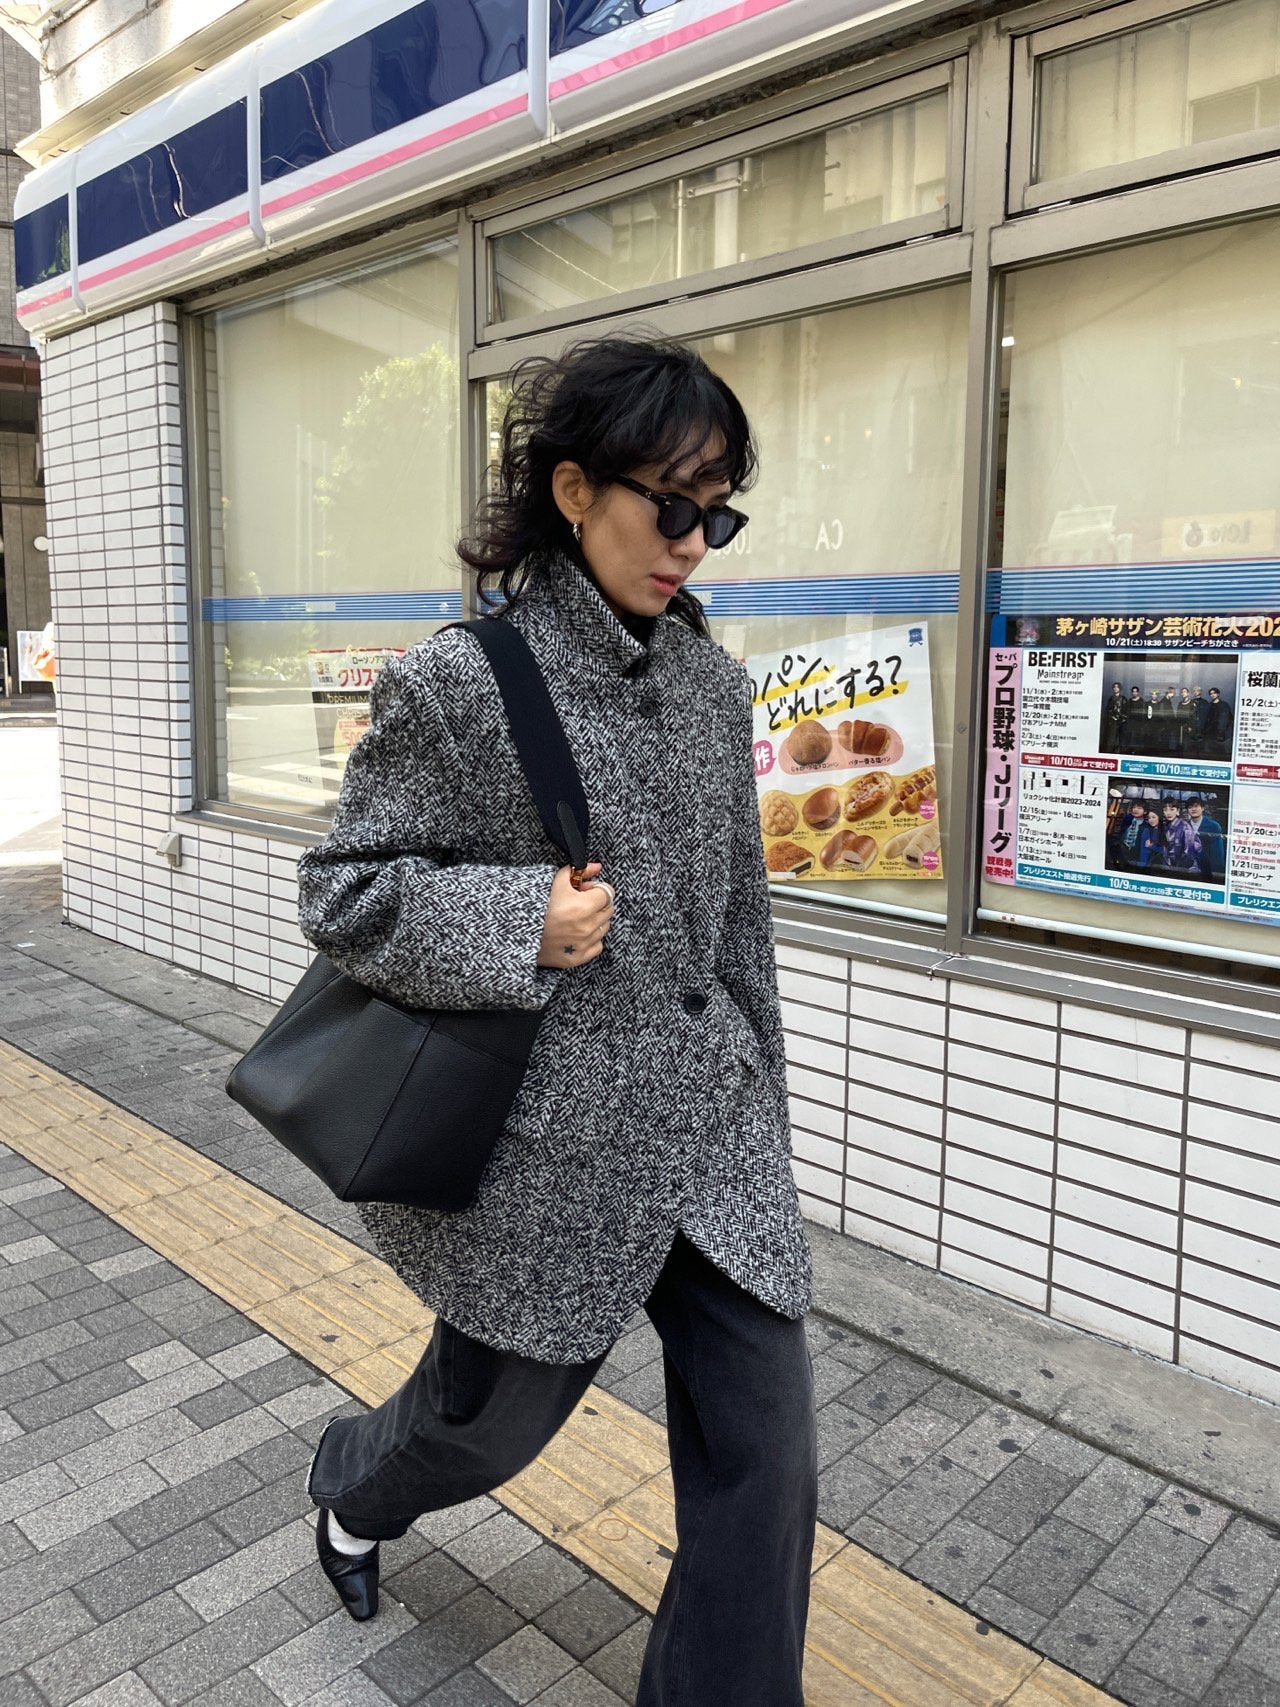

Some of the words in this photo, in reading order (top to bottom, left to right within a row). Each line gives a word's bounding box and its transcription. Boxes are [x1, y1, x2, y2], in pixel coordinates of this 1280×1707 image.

[1165, 638, 1239, 647] サザンビーチちがさき
[1028, 652, 1097, 667] BE:FIRST
[338, 668, 381, 687] クリス
[990, 663, 1018, 854] プロ野球・Jリーグ
